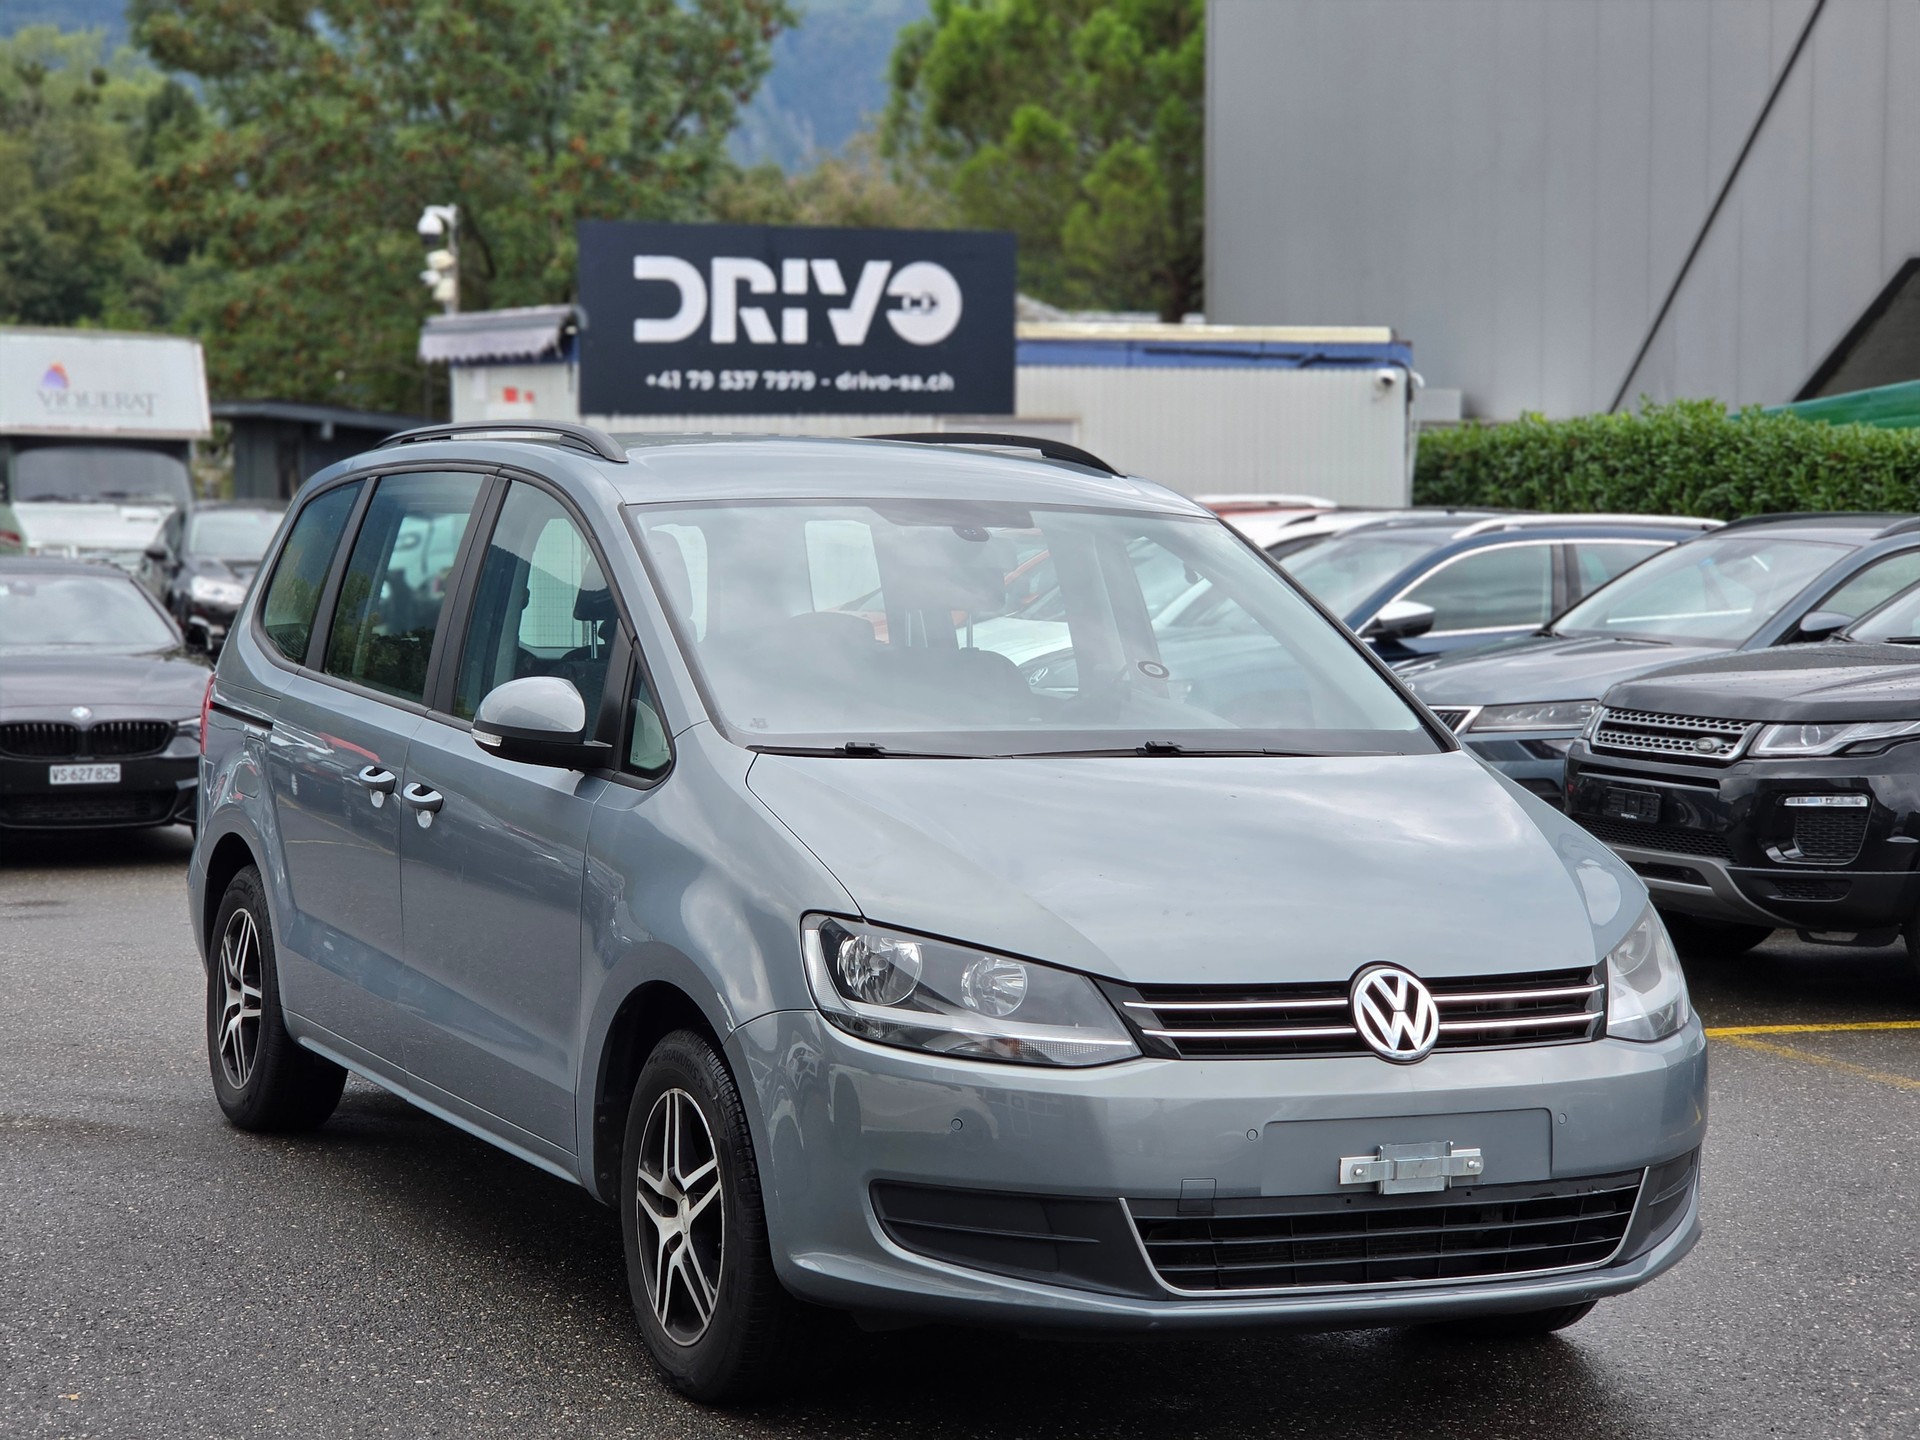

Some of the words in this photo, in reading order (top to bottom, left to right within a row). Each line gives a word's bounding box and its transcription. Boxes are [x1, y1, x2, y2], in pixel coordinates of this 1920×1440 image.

[633, 255, 963, 345] DRIVO
[646, 370, 681, 390] +41
[686, 370, 715, 391] 79
[719, 370, 758, 391] 537
[762, 370, 816, 391] 7979
[835, 371, 954, 392] drivo-sa.ch
